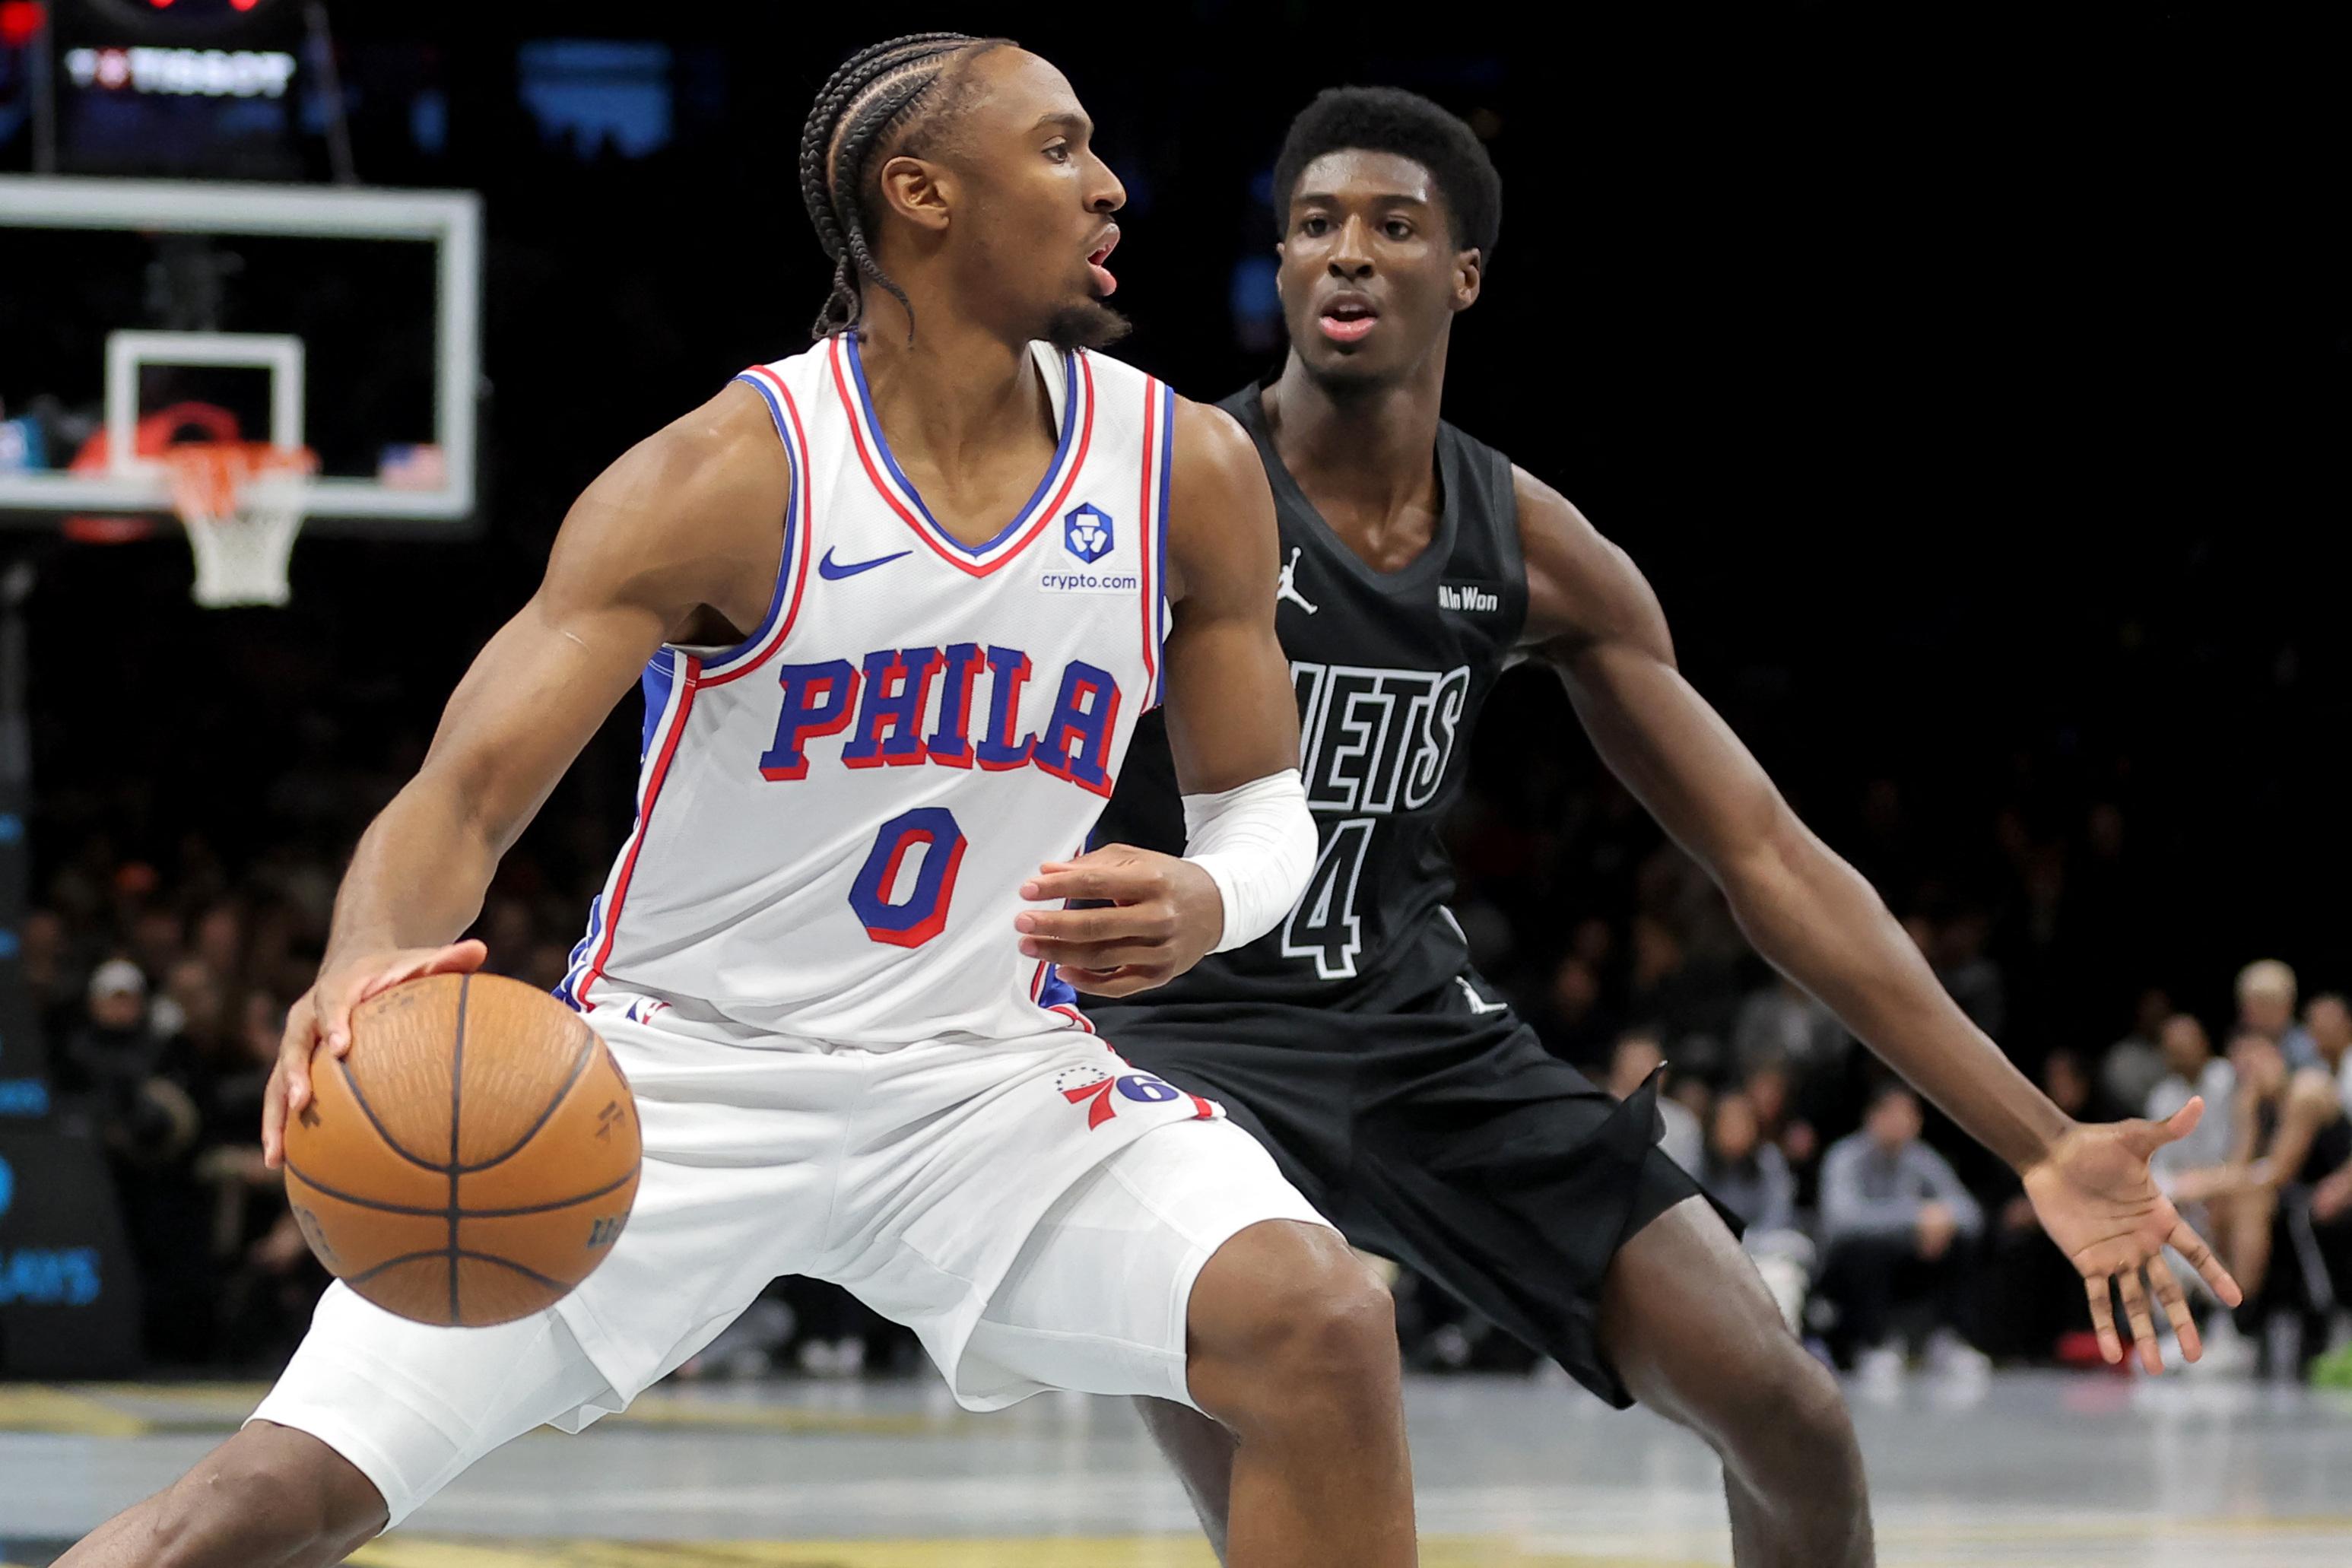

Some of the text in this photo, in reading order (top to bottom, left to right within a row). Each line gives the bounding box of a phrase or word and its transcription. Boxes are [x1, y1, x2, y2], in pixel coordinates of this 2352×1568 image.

[1041, 573, 1137, 591] crypto.com
[759, 642, 1122, 799] PHILA
[847, 806, 968, 949] 0
[1281, 817, 1377, 980] 4
[1061, 1074, 1179, 1132] 76
